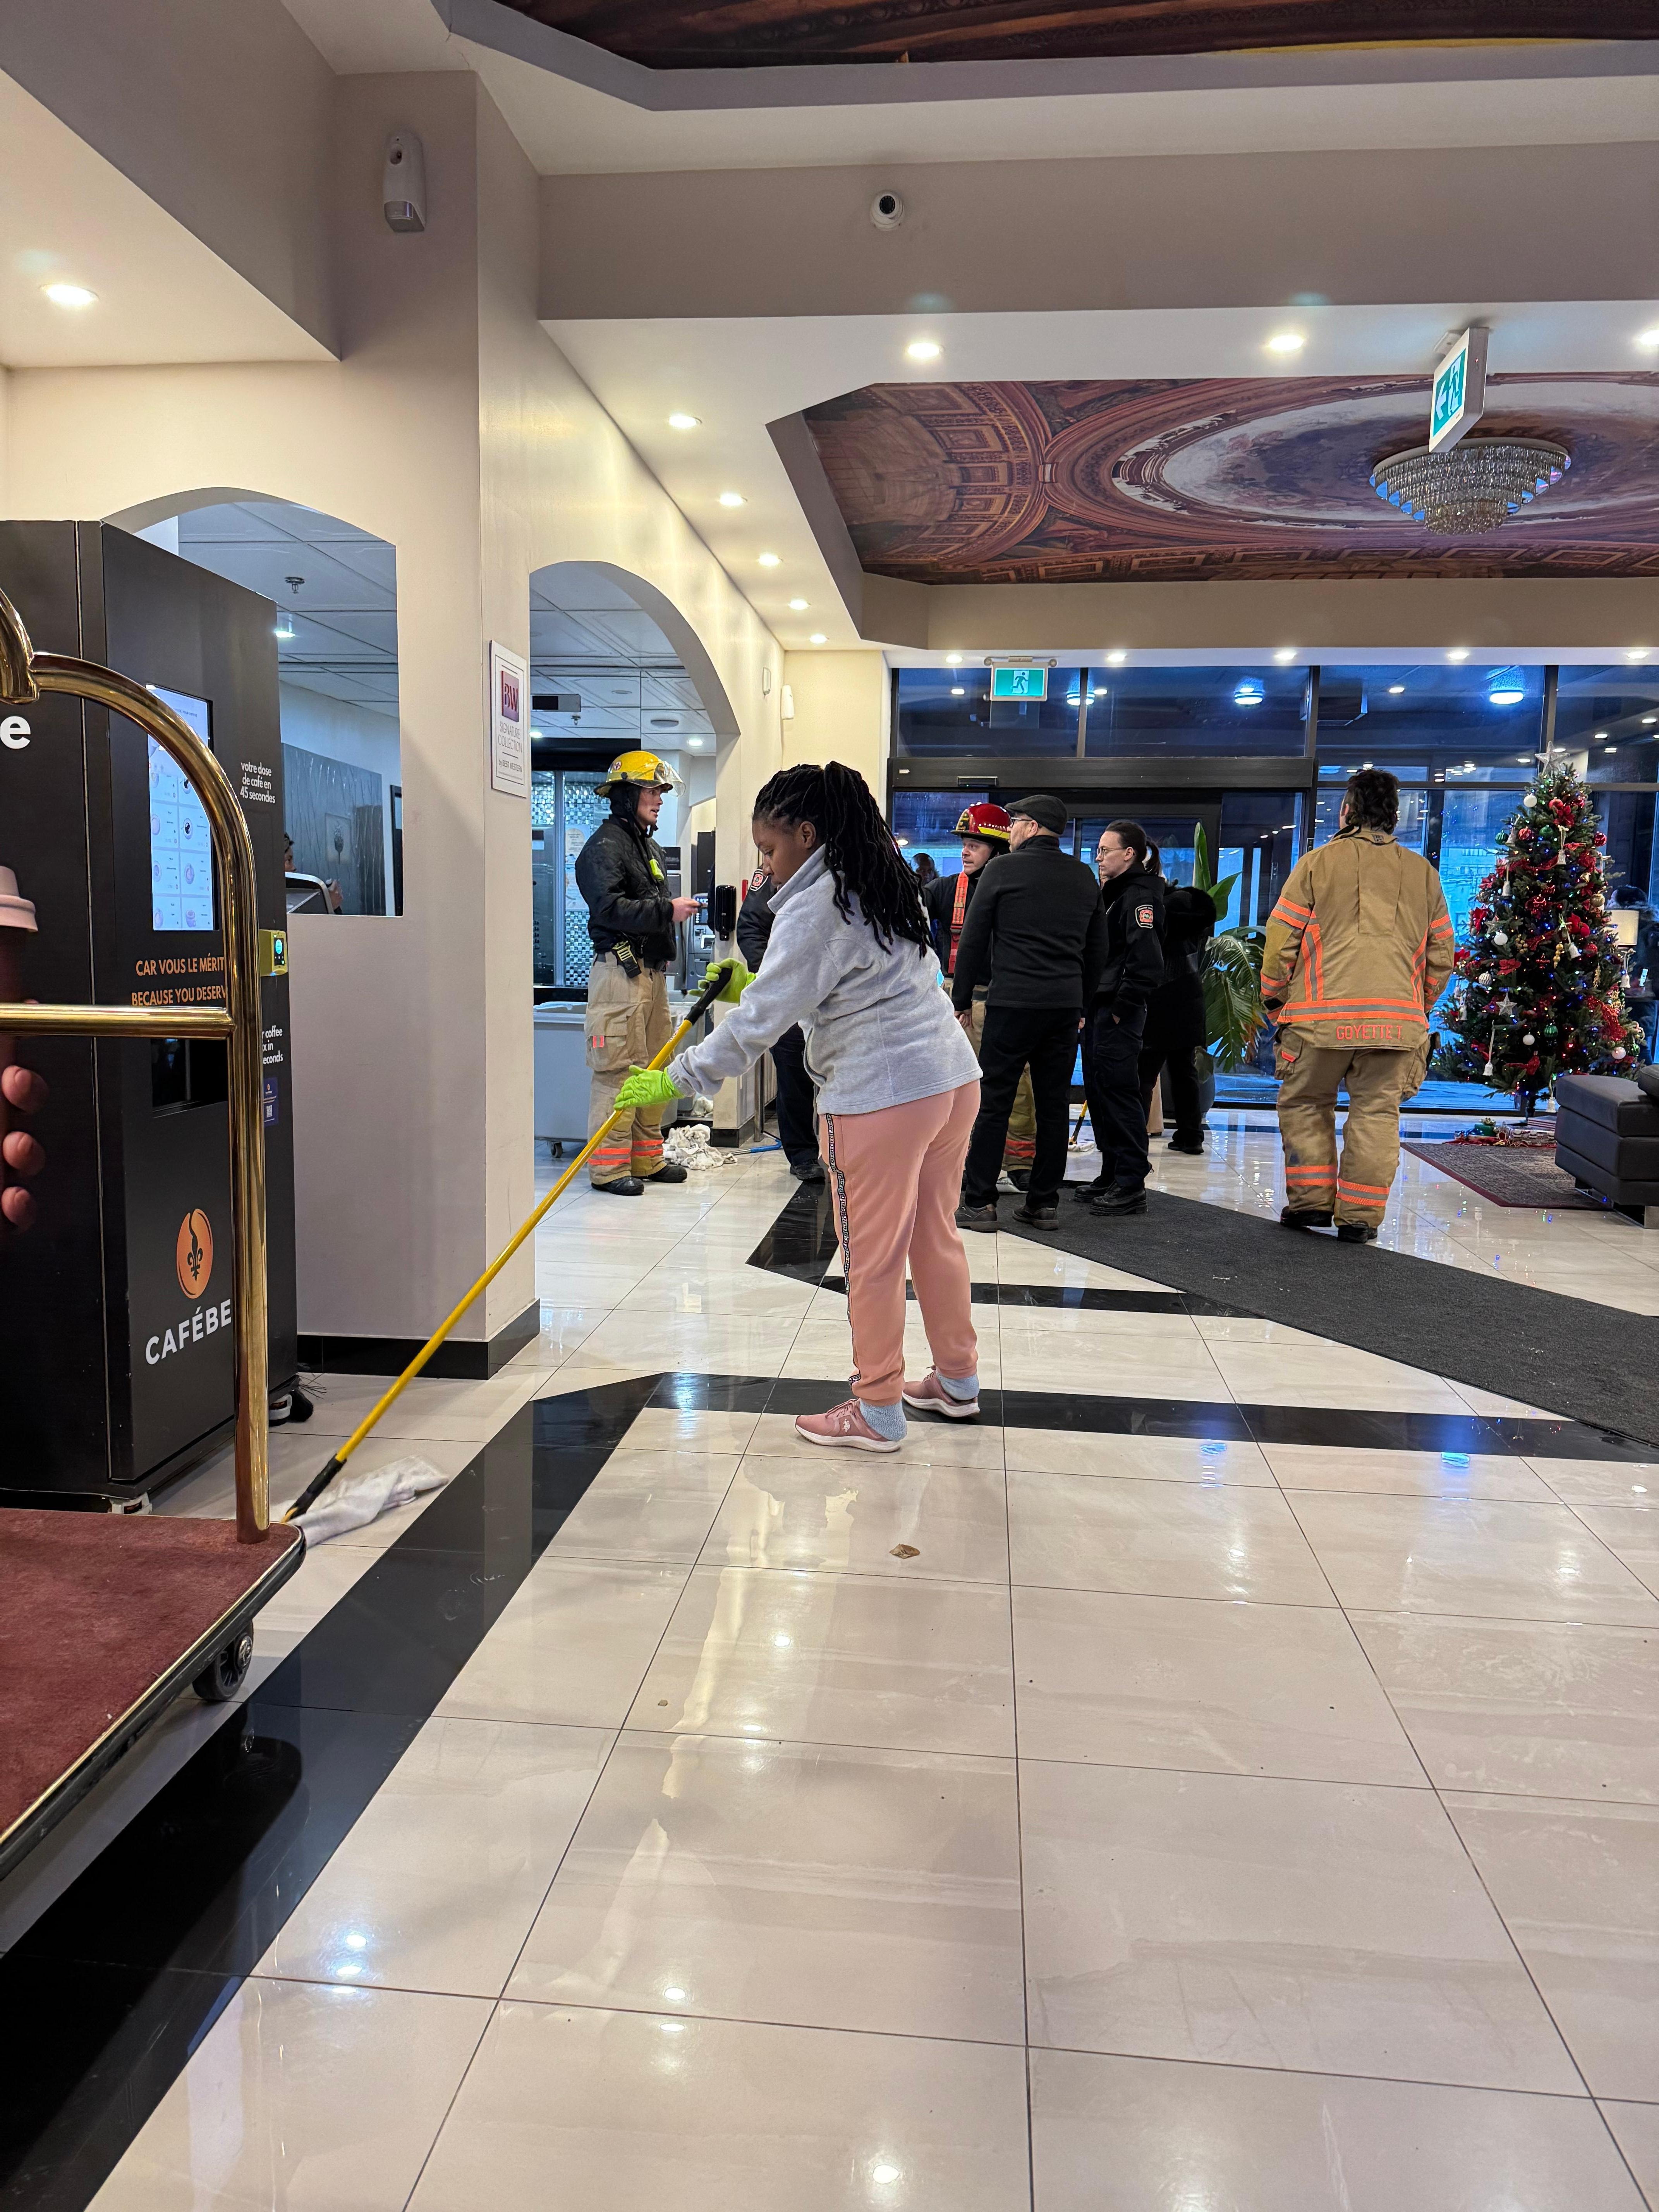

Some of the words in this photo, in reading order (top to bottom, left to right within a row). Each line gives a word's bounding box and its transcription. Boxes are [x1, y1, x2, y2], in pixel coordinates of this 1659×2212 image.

[504, 683, 518, 712] BW
[500, 721, 520, 740] SIGNATURE
[498, 734, 522, 753] COLLECTION
[240, 761, 257, 773] votre
[258, 762, 272, 776] dose
[242, 772, 250, 785] de
[251, 775, 263, 788] café
[263, 781, 271, 790] en
[240, 786, 248, 799] 45
[249, 790, 276, 804] secondes
[136, 960, 157, 976] CAR
[158, 958, 186, 975] VOUS
[188, 958, 198, 973] LE
[199, 952, 225, 972] MÉRIT
[132, 989, 173, 1006] BECAUSE
[175, 988, 194, 1003] YOU
[196, 985, 226, 1001] DESERV
[265, 1025, 283, 1038] coffee
[1336, 1024, 1393, 1040] GOYETTE
[268, 1039, 273, 1051] in
[263, 1050, 283, 1065] econds
[145, 1298, 232, 1365] CAFÉBE
